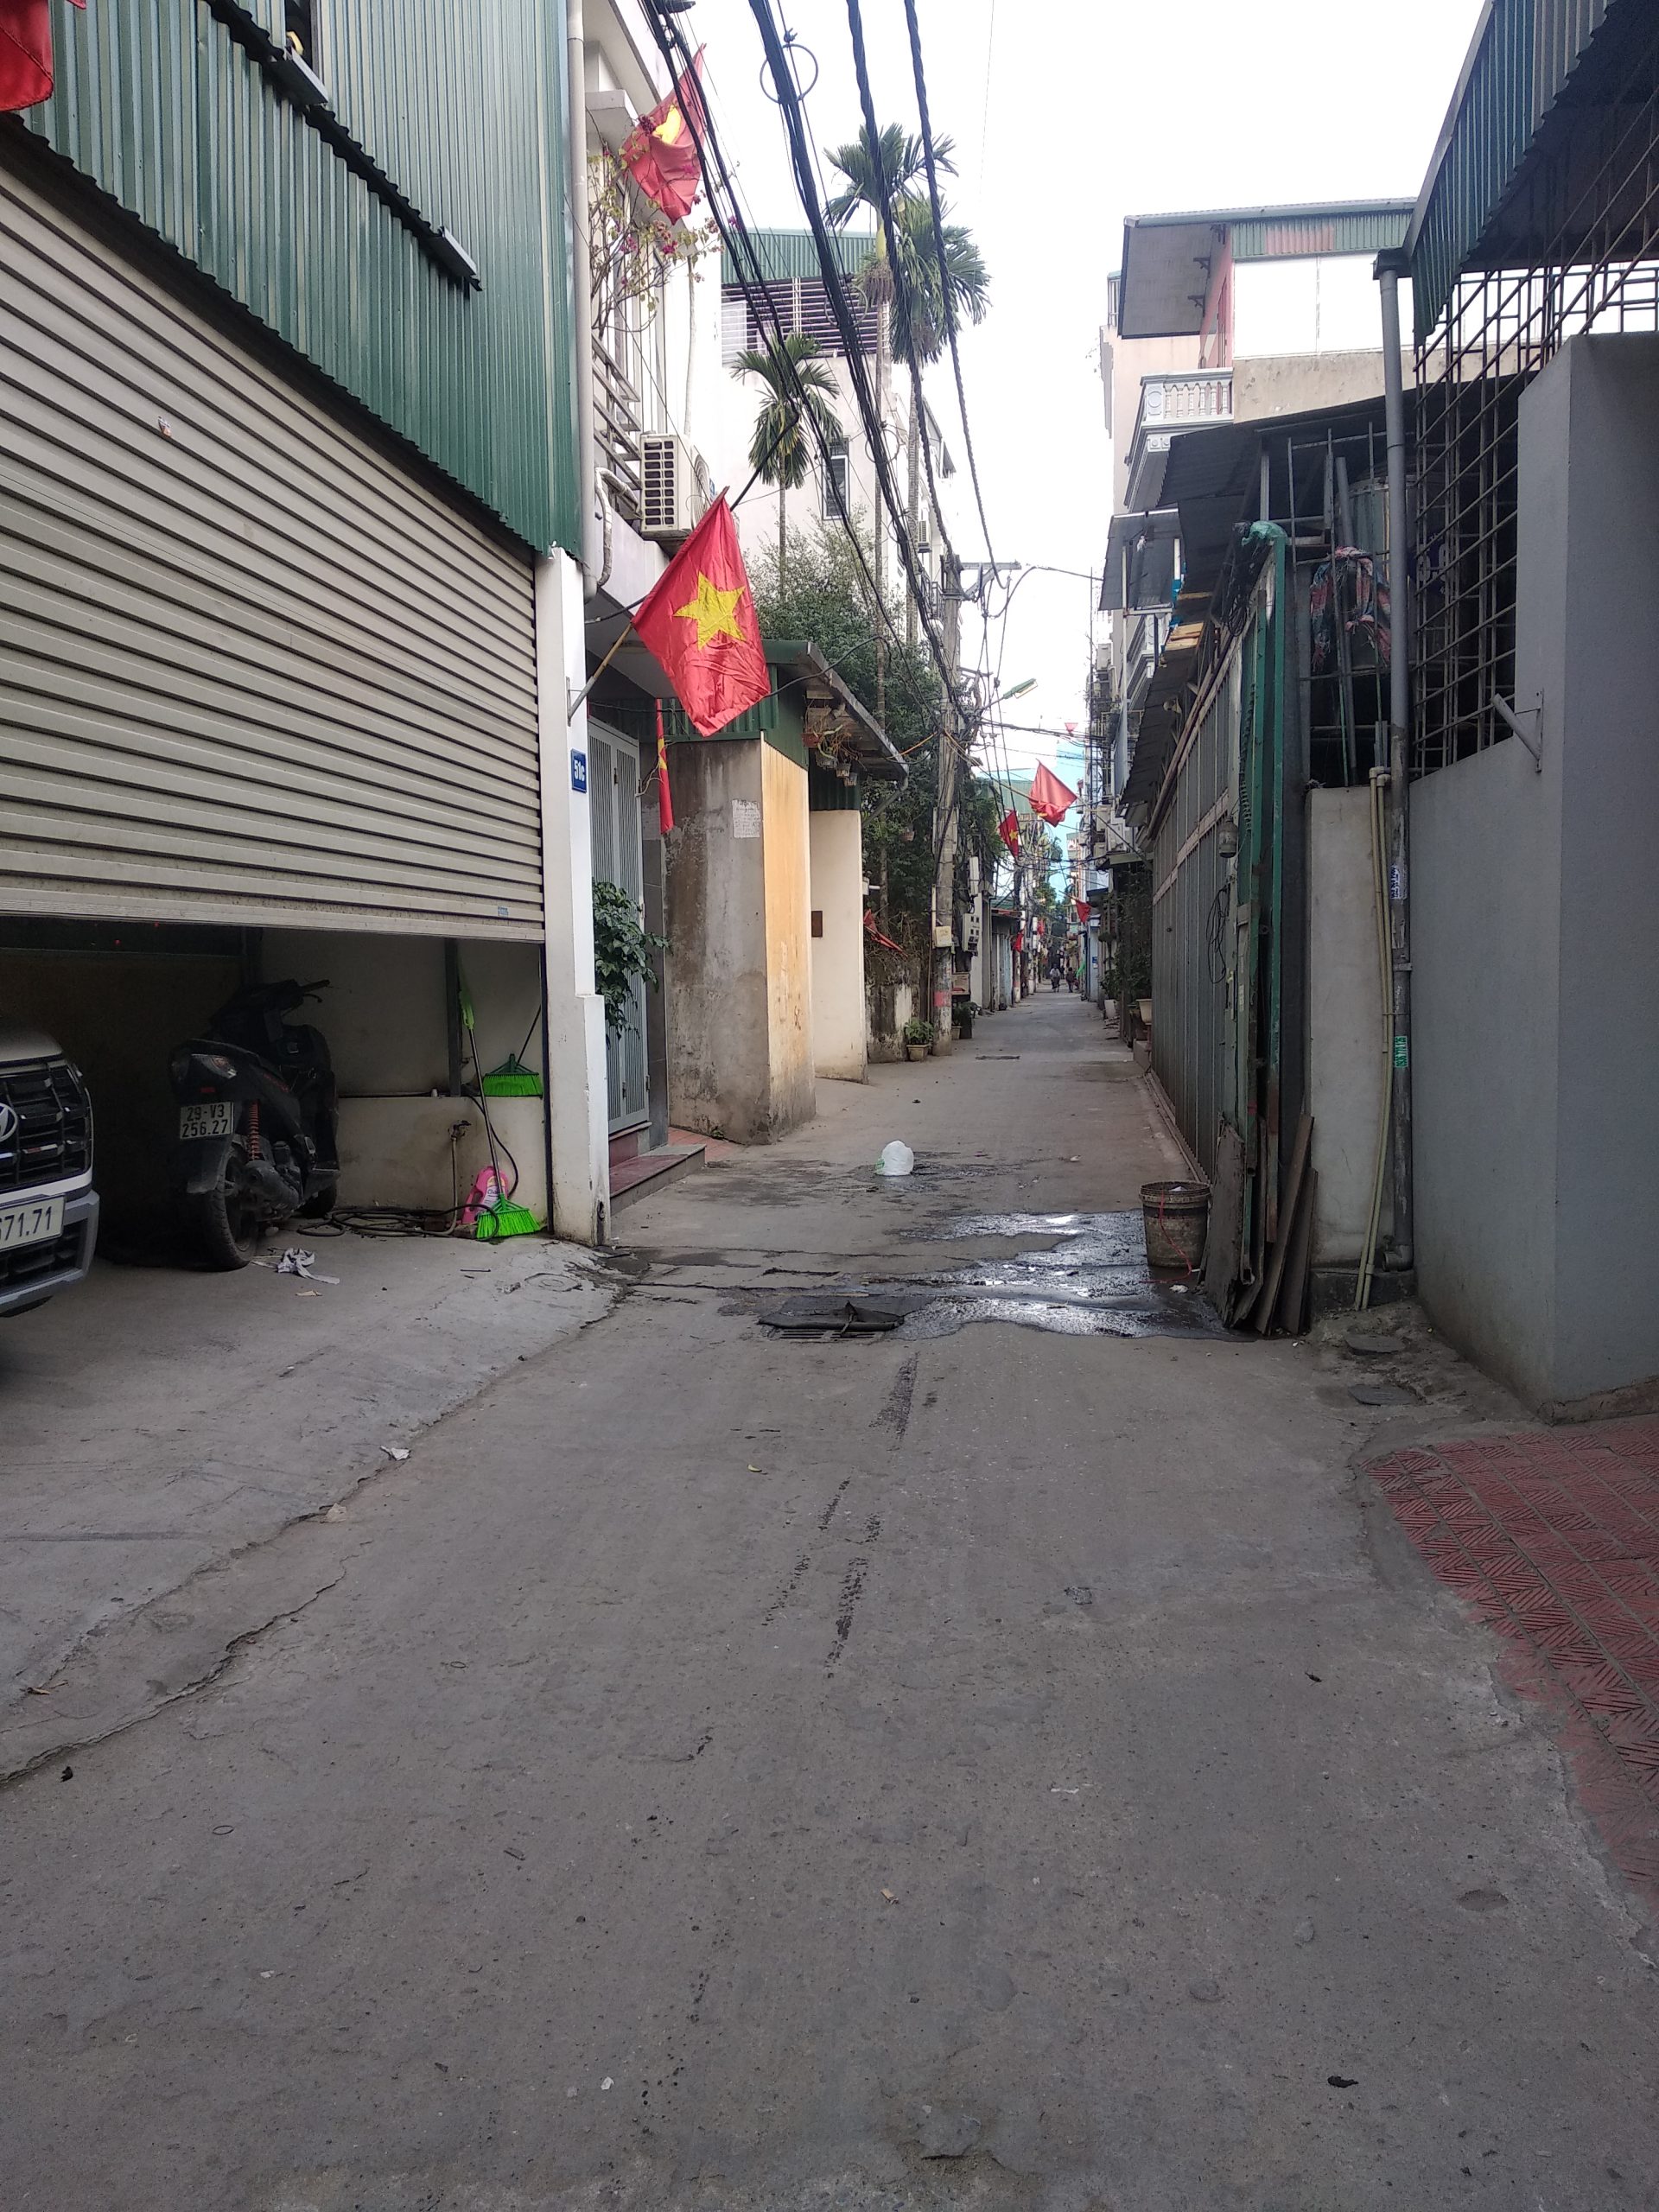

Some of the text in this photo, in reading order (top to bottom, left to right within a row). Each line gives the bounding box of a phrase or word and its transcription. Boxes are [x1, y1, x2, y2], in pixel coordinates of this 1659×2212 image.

[187, 1104, 225, 1122] 29-V3
[181, 1119, 228, 1138] 256.27
[0, 1206, 52, 1242] 71.71
